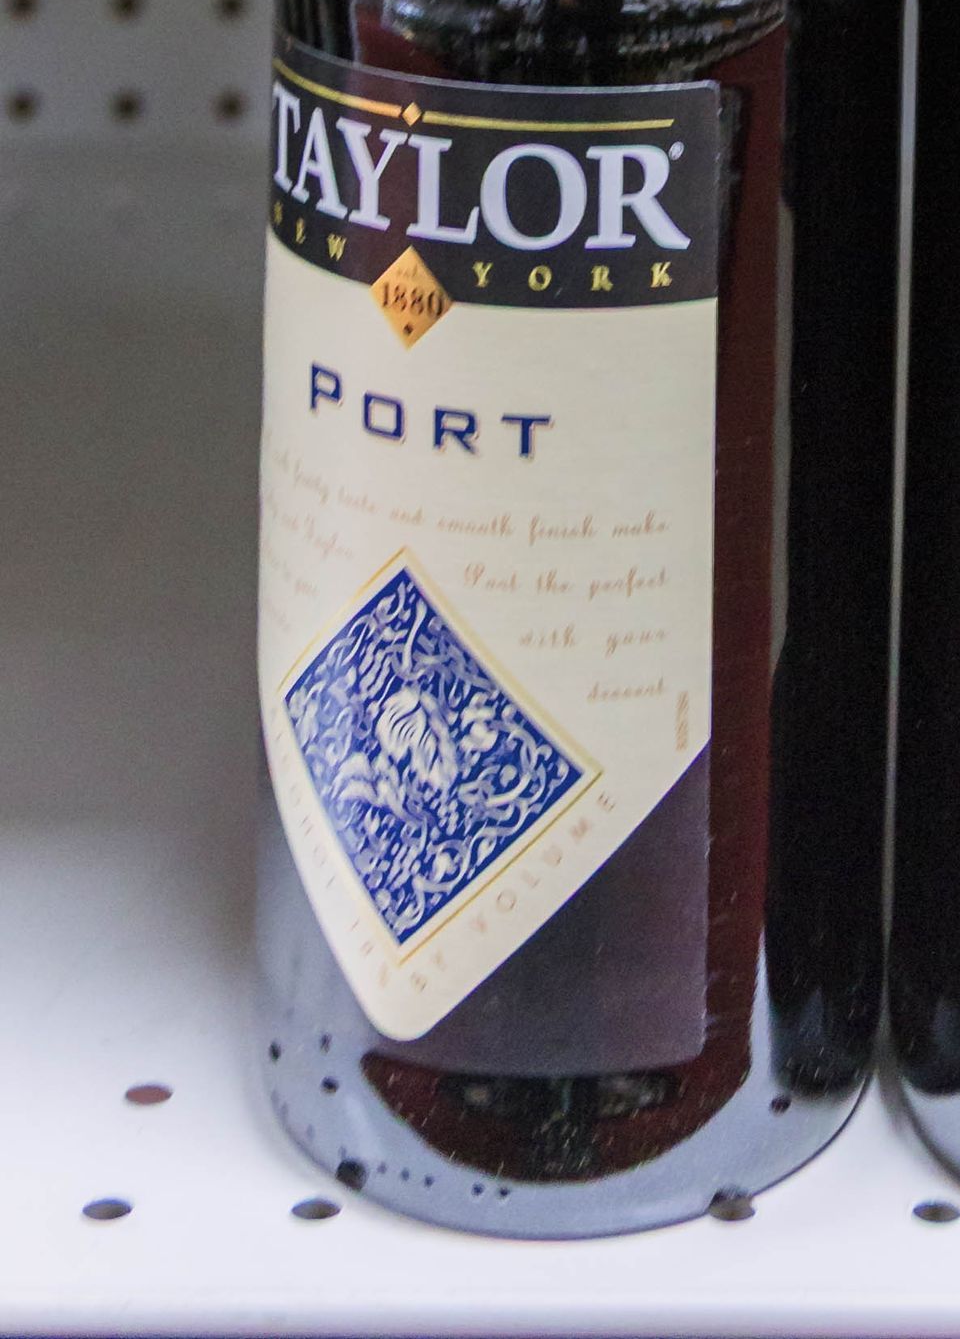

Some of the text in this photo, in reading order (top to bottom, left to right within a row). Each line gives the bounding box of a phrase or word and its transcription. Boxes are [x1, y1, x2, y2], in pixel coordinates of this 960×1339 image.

[272, 81, 691, 251] TAYLOR
[381, 282, 444, 318] 1880
[472, 262, 673, 291] YORK
[310, 362, 555, 458] PORT
